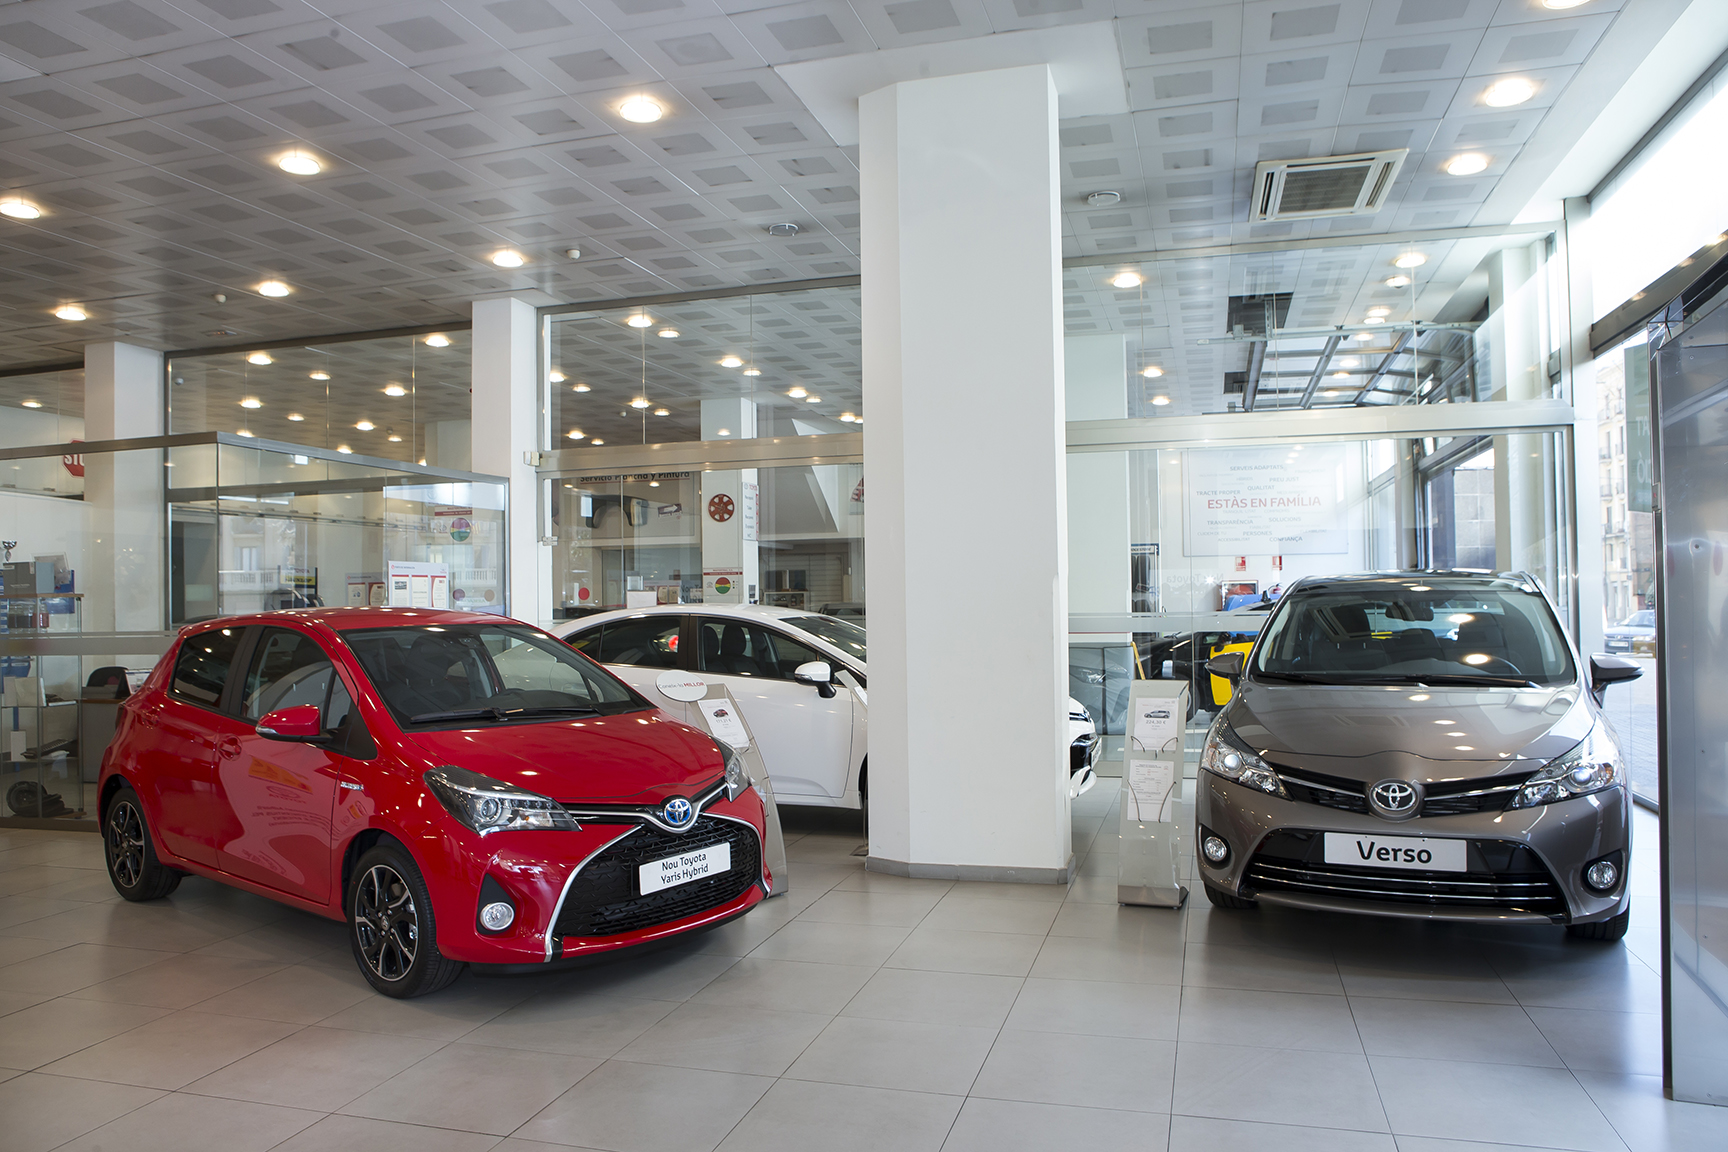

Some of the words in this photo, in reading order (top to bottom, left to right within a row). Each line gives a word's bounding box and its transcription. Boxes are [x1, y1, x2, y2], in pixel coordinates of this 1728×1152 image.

[1207, 496, 1248, 509] ESTÀS
[1250, 498, 1267, 508] EN
[1270, 494, 1321, 507] FAMÍLIA
[1356, 840, 1432, 864] Verso
[662, 860, 678, 872] Nou
[680, 853, 707, 867] Toyota
[661, 872, 681, 884] Yaris
[682, 863, 709, 880] Hybrid
